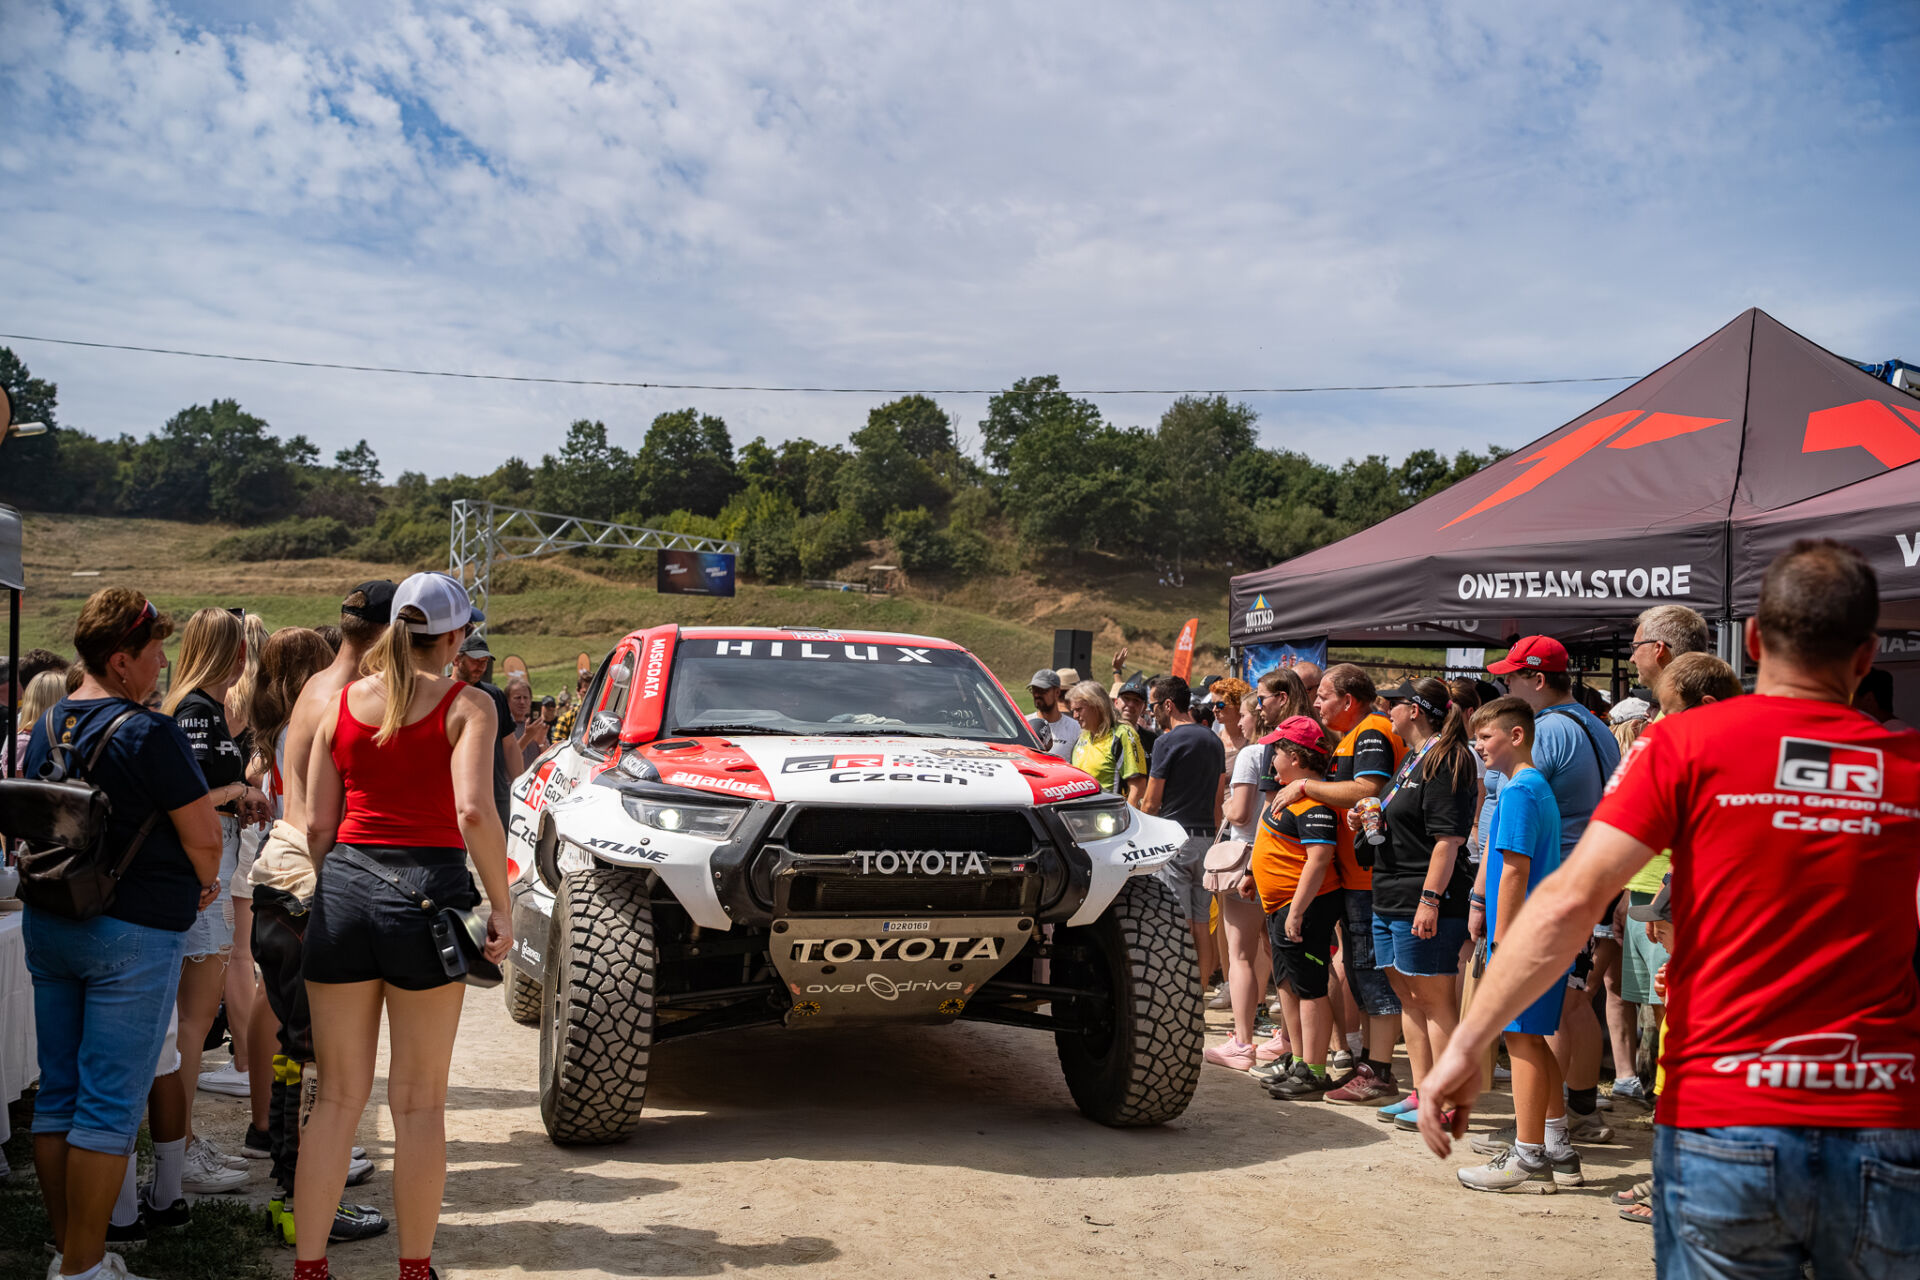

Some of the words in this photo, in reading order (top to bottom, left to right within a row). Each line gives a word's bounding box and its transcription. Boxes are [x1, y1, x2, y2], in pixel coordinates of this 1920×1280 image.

[1458, 564, 1691, 600] ONETEAM.STORE
[1246, 609, 1274, 628] MITKO
[716, 641, 932, 663] HILUX
[643, 638, 666, 699] MUSICDATA
[782, 756, 884, 774] GR
[1780, 753, 1881, 795] GR
[671, 771, 762, 794] agados
[829, 772, 968, 786] Czech
[1041, 779, 1097, 801] agados
[1716, 793, 1800, 807] TOYOTA
[1803, 794, 1876, 811] GAZOO
[1772, 810, 1882, 836] Czech
[584, 837, 668, 863] XTLINE
[1122, 843, 1179, 863] XTLINE
[857, 850, 985, 875] TOYOTA
[794, 936, 999, 963] TOYOTA
[1746, 1062, 1897, 1090] HILUX
